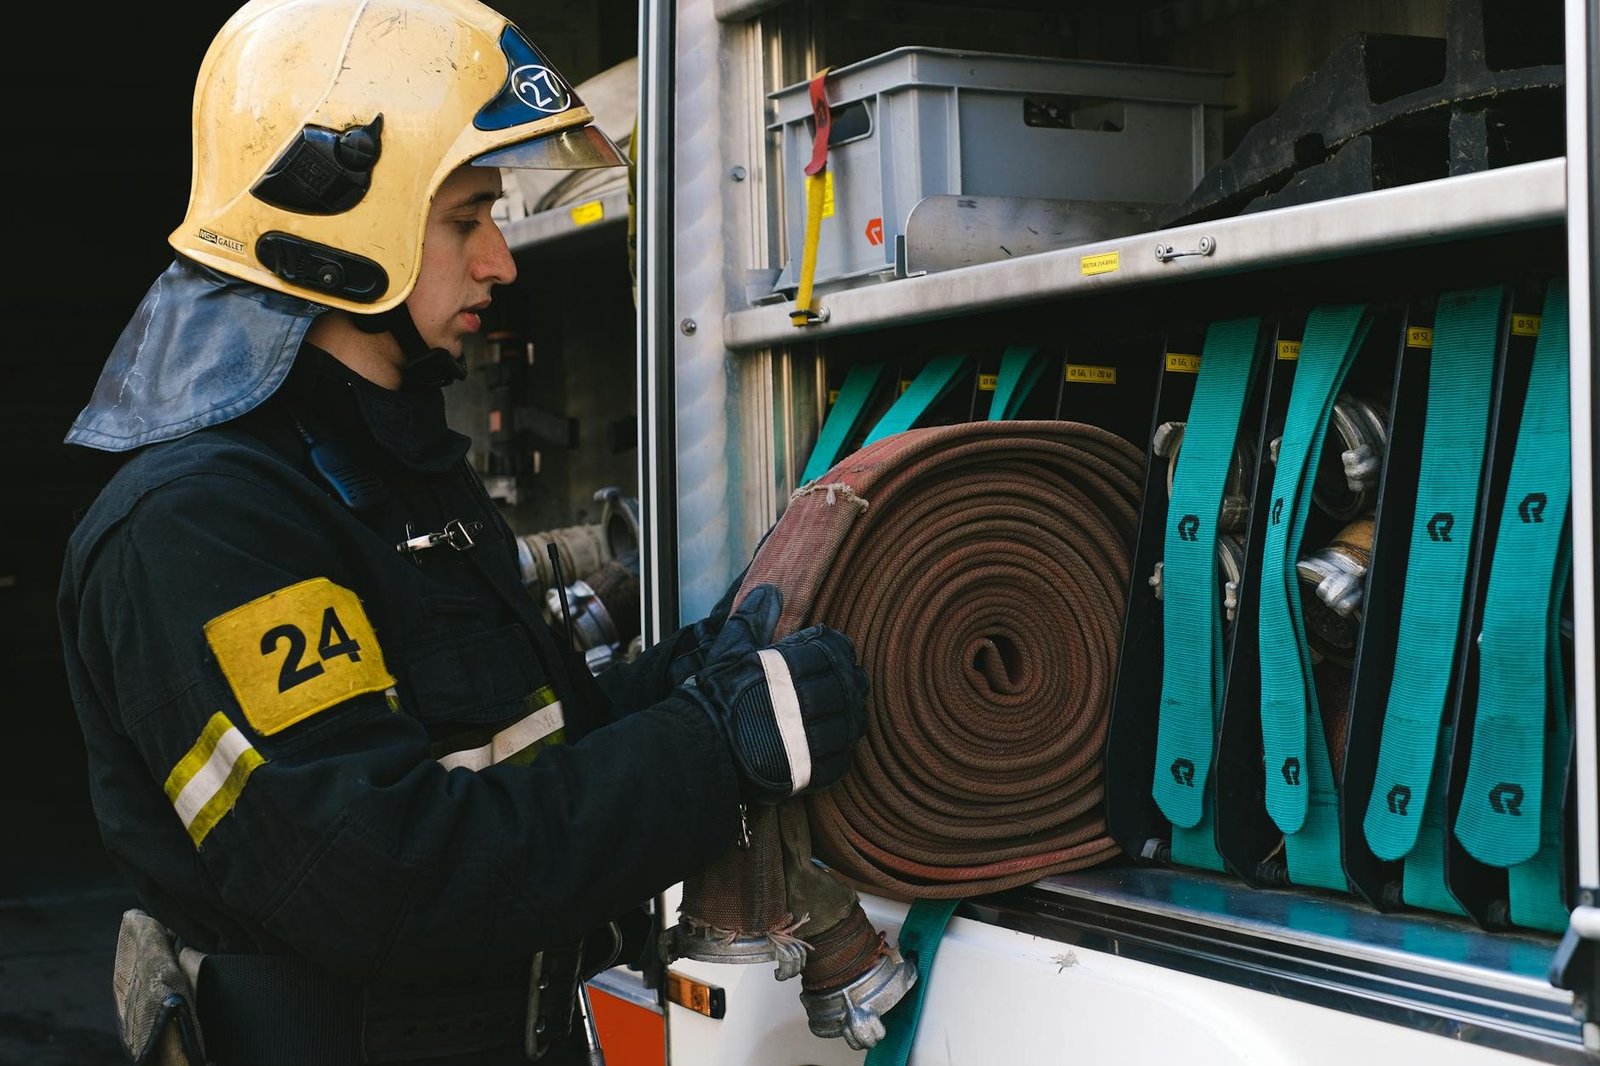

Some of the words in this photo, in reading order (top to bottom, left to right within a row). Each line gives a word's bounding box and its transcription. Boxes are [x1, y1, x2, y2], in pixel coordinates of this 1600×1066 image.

[519, 69, 560, 108] 27
[218, 237, 245, 252] GALLET
[260, 606, 361, 694] 24
